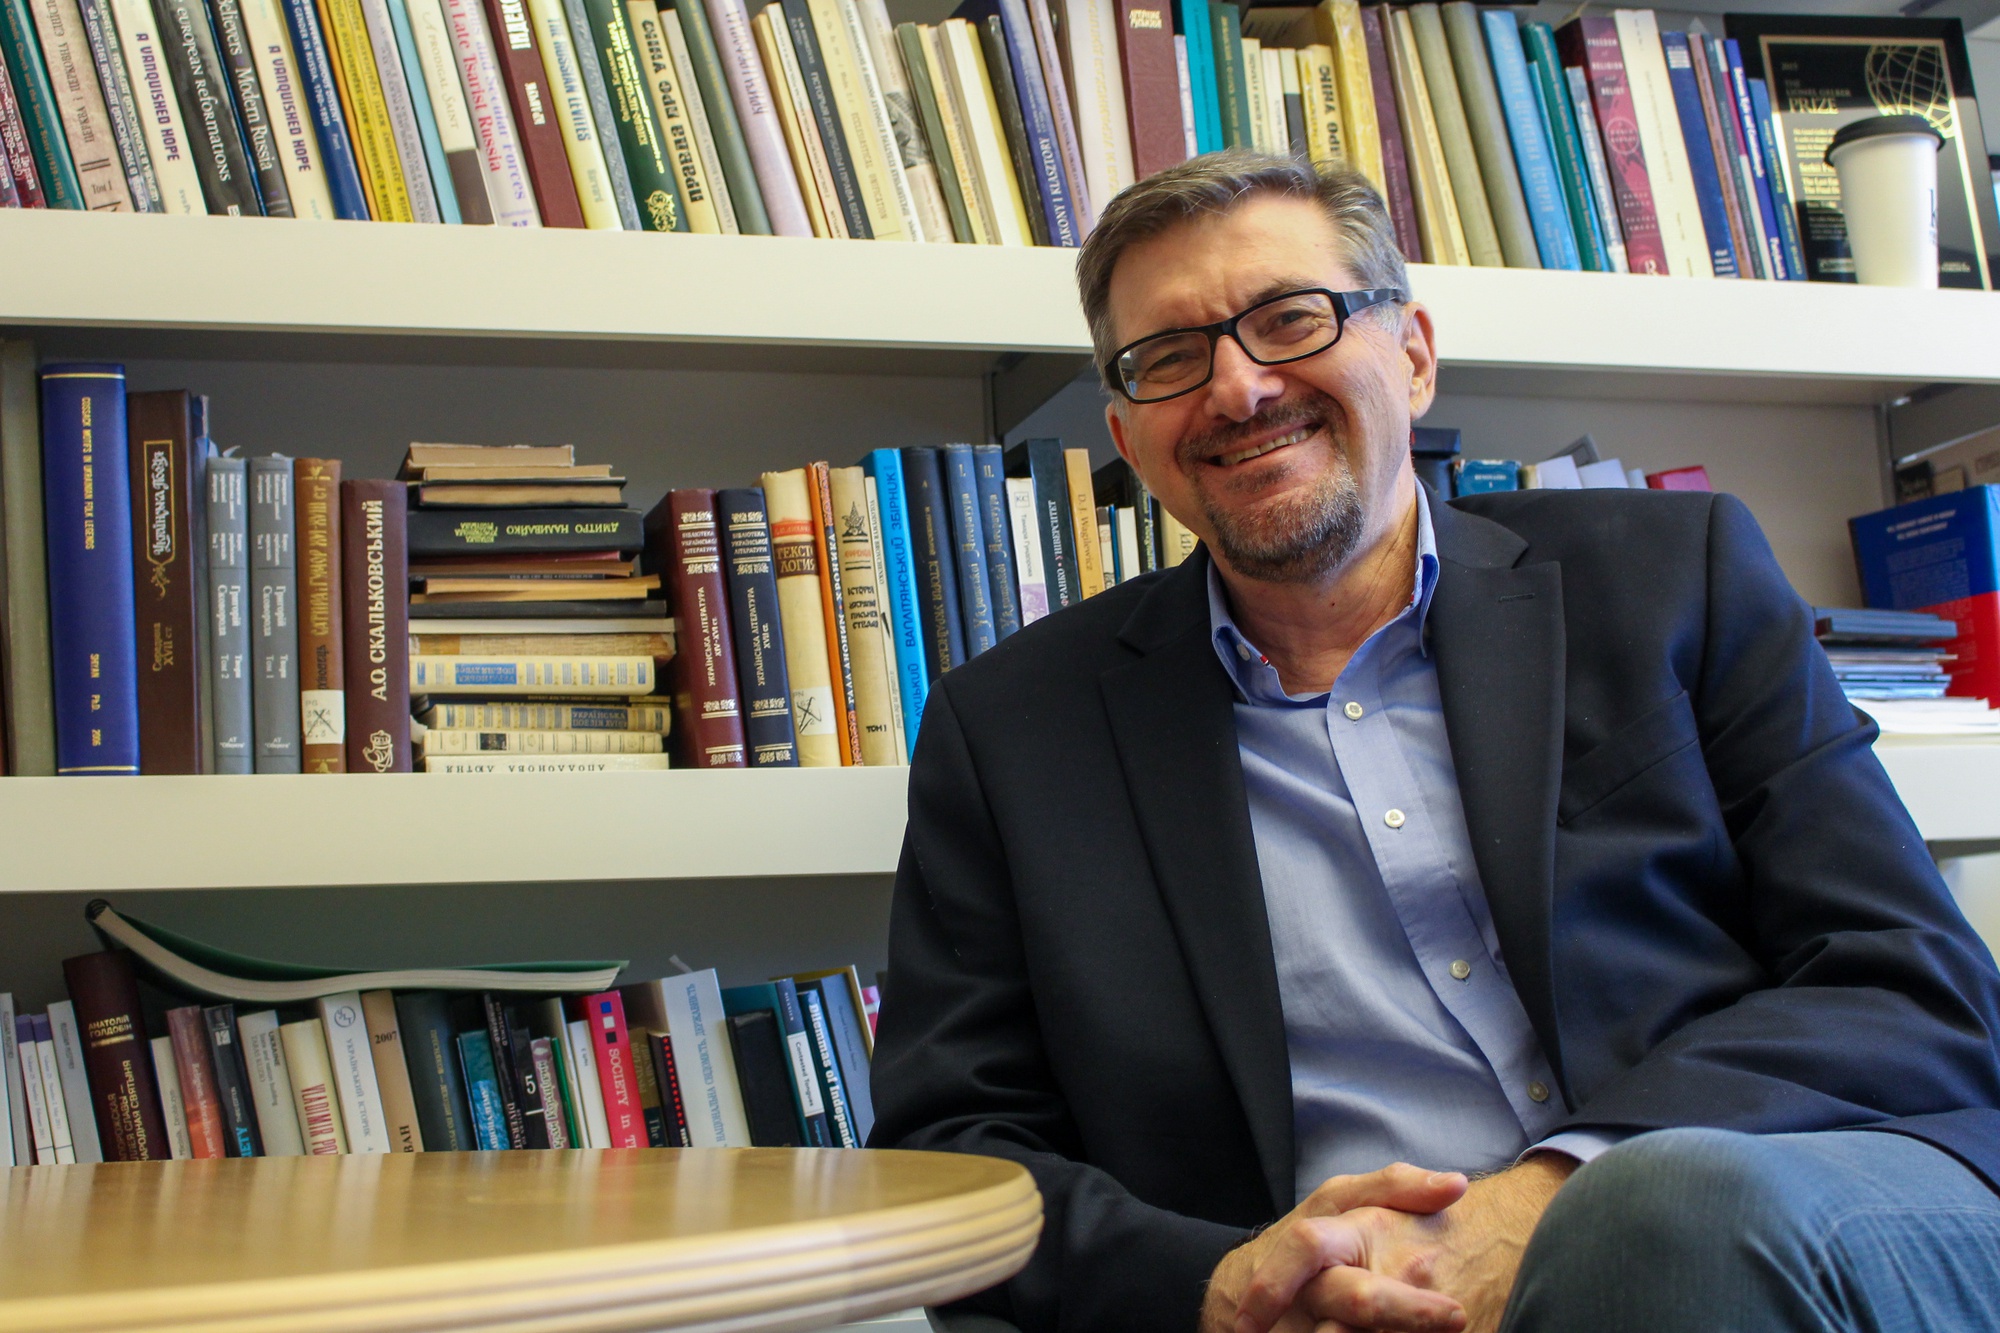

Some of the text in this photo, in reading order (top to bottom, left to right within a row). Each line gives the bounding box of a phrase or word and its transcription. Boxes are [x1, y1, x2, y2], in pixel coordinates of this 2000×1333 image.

[135, 31, 181, 162] A VANQUISHED HOPE
[232, 64, 278, 171] Modern Russia
[268, 43, 311, 173] A VANQUISHED HOPE
[450, 12, 505, 173] Late Tsarist Russia
[553, 39, 578, 93] RUSSIAN
[567, 94, 590, 142] LEVITES
[657, 78, 679, 120] ПРО
[1789, 97, 1839, 115] PRIZE
[1036, 135, 1062, 195] KLASZTORY
[1052, 202, 1074, 247] ZAKONY
[885, 471, 902, 530] ЗБІРНИК
[1077, 493, 1086, 504] D.
[505, 521, 618, 536] ДМИТРО НАЛИВАЙКО
[1047, 499, 1069, 606] ФРАНКО УНІВЕРСИТЕТ
[1078, 516, 1096, 571] Wagilewicz
[826, 532, 843, 600] ХРОНИКА
[216, 584, 228, 636] Сковорода
[228, 584, 241, 626] Григорій
[273, 585, 287, 626] Григорій
[361, 499, 388, 701] А.О. СКАЛЬКОВСЬКИЙ
[261, 585, 274, 672] Сковорода Том
[696, 586, 716, 686] УКРАЇНСЬКА ЛІТЕРАТУРА
[746, 586, 765, 686] УКРАЇНСЬКА ЛІТЕРАТУРА
[836, 613, 851, 669] АНОНИМ
[220, 654, 229, 670] Том
[508, 764, 604, 772] АПОЛЛОНОВА
[375, 1030, 397, 1044] 2007
[807, 1002, 833, 1068] Dilemmas
[824, 1069, 837, 1083] of
[121, 1059, 139, 1109] СВЯТЫНЯ
[345, 1038, 364, 1097] УКРАЇНСЬКИЙ
[525, 1074, 536, 1095] 5
[606, 1047, 632, 1128] SOCIETY in
[794, 1041, 814, 1107] Contested Tongues
[118, 1095, 133, 1131] СЛАВЫ
[300, 1083, 335, 1137] VLADIMIR
[205, 1136, 216, 1152] and
